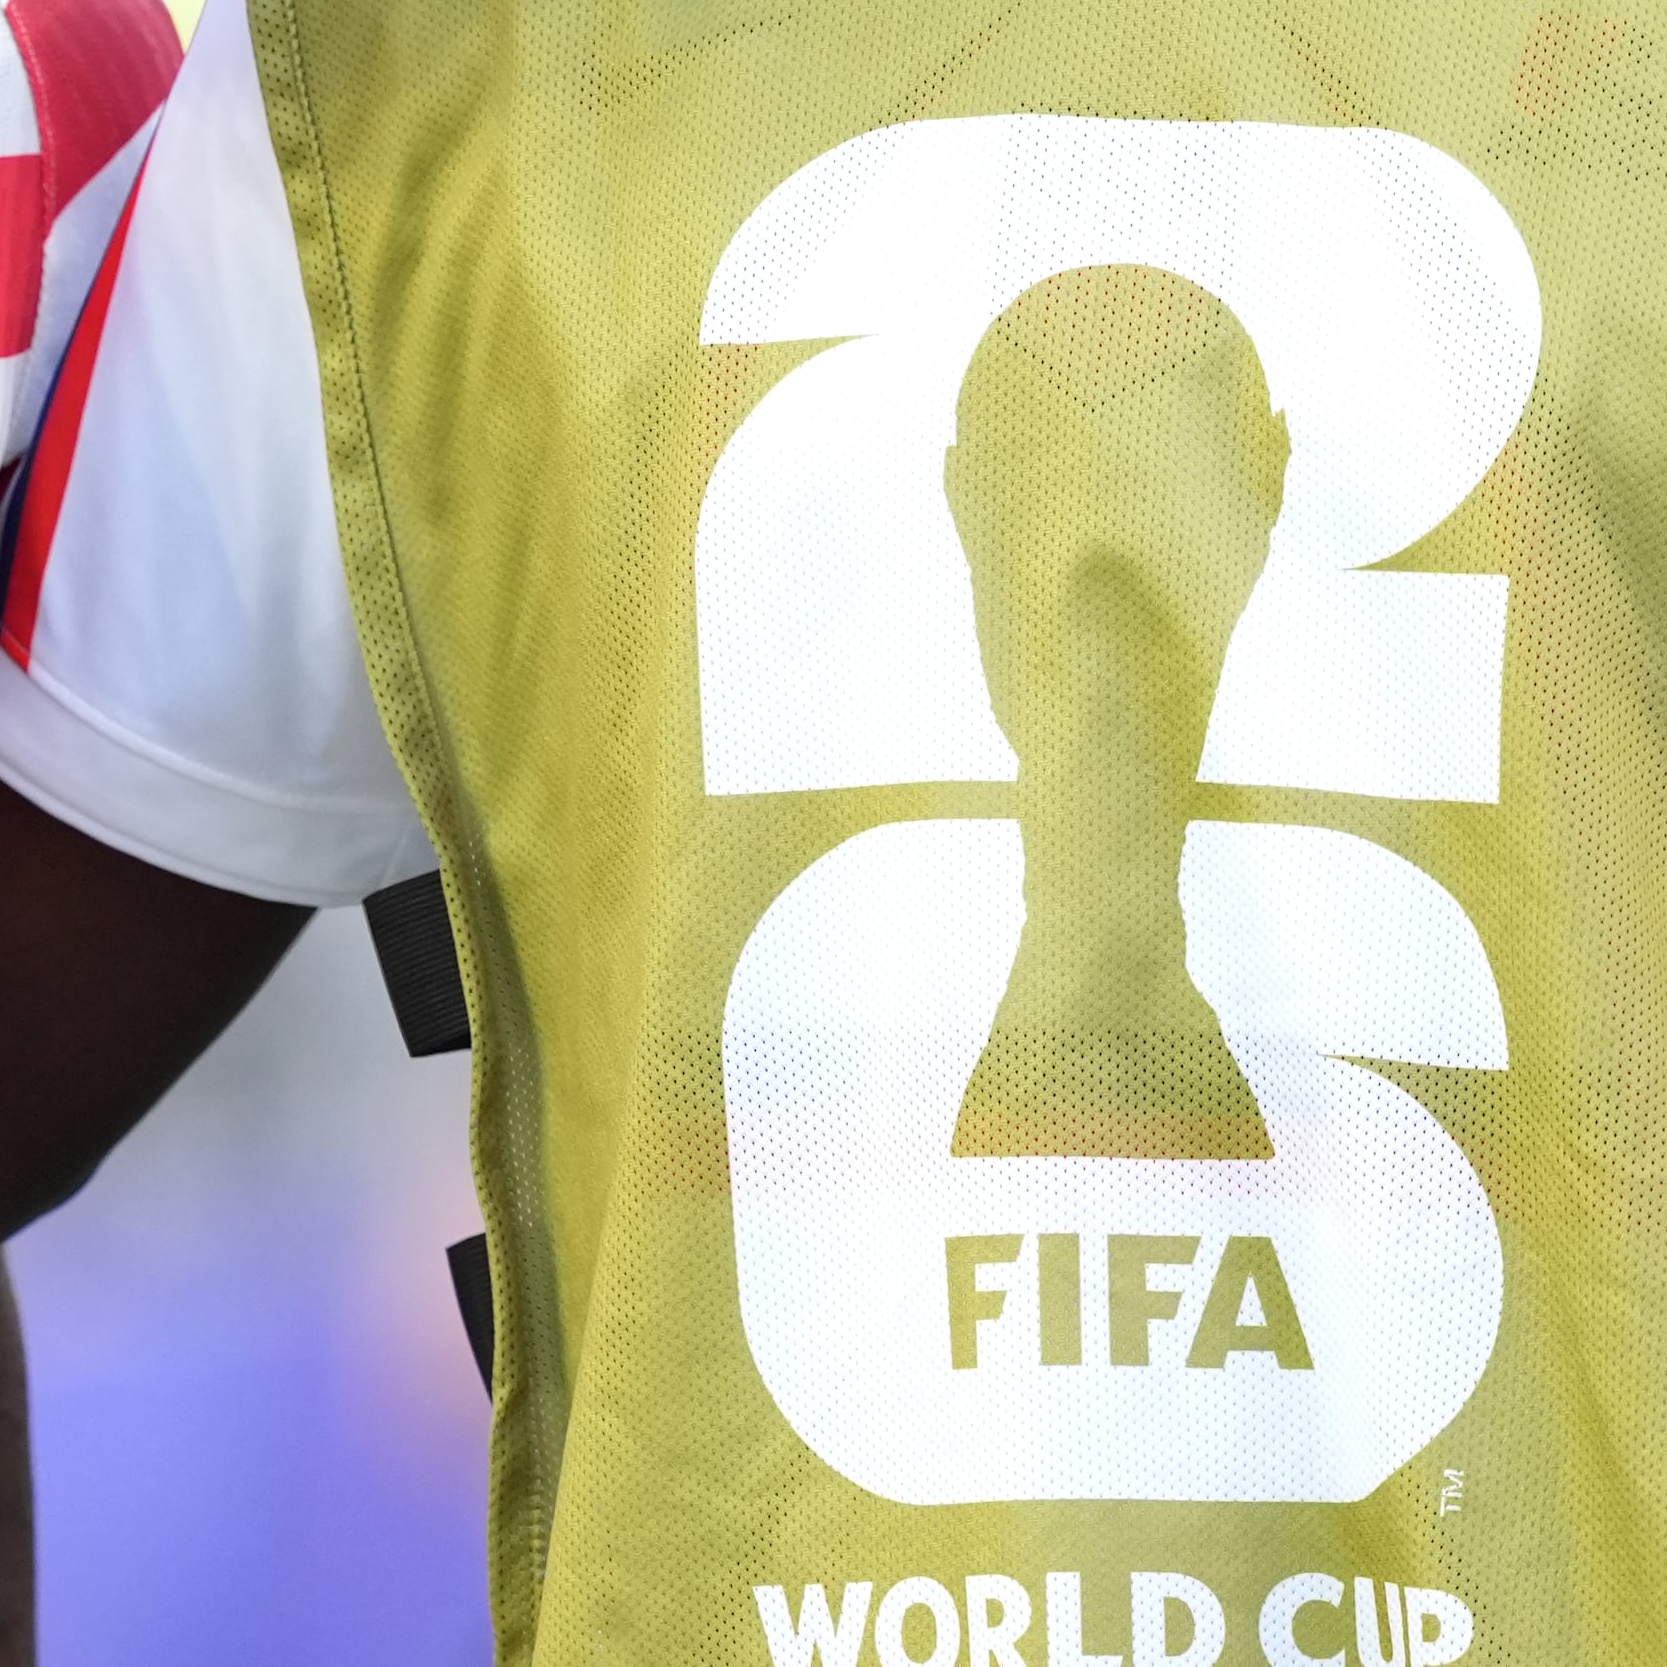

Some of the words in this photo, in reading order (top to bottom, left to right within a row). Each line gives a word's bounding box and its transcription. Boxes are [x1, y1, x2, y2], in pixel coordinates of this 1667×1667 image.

[944, 1232, 1316, 1371] FIFA
[1439, 1468, 1465, 1518] TM
[752, 1571, 1226, 1667] WORLD
[1257, 1571, 1475, 1667] CUP
